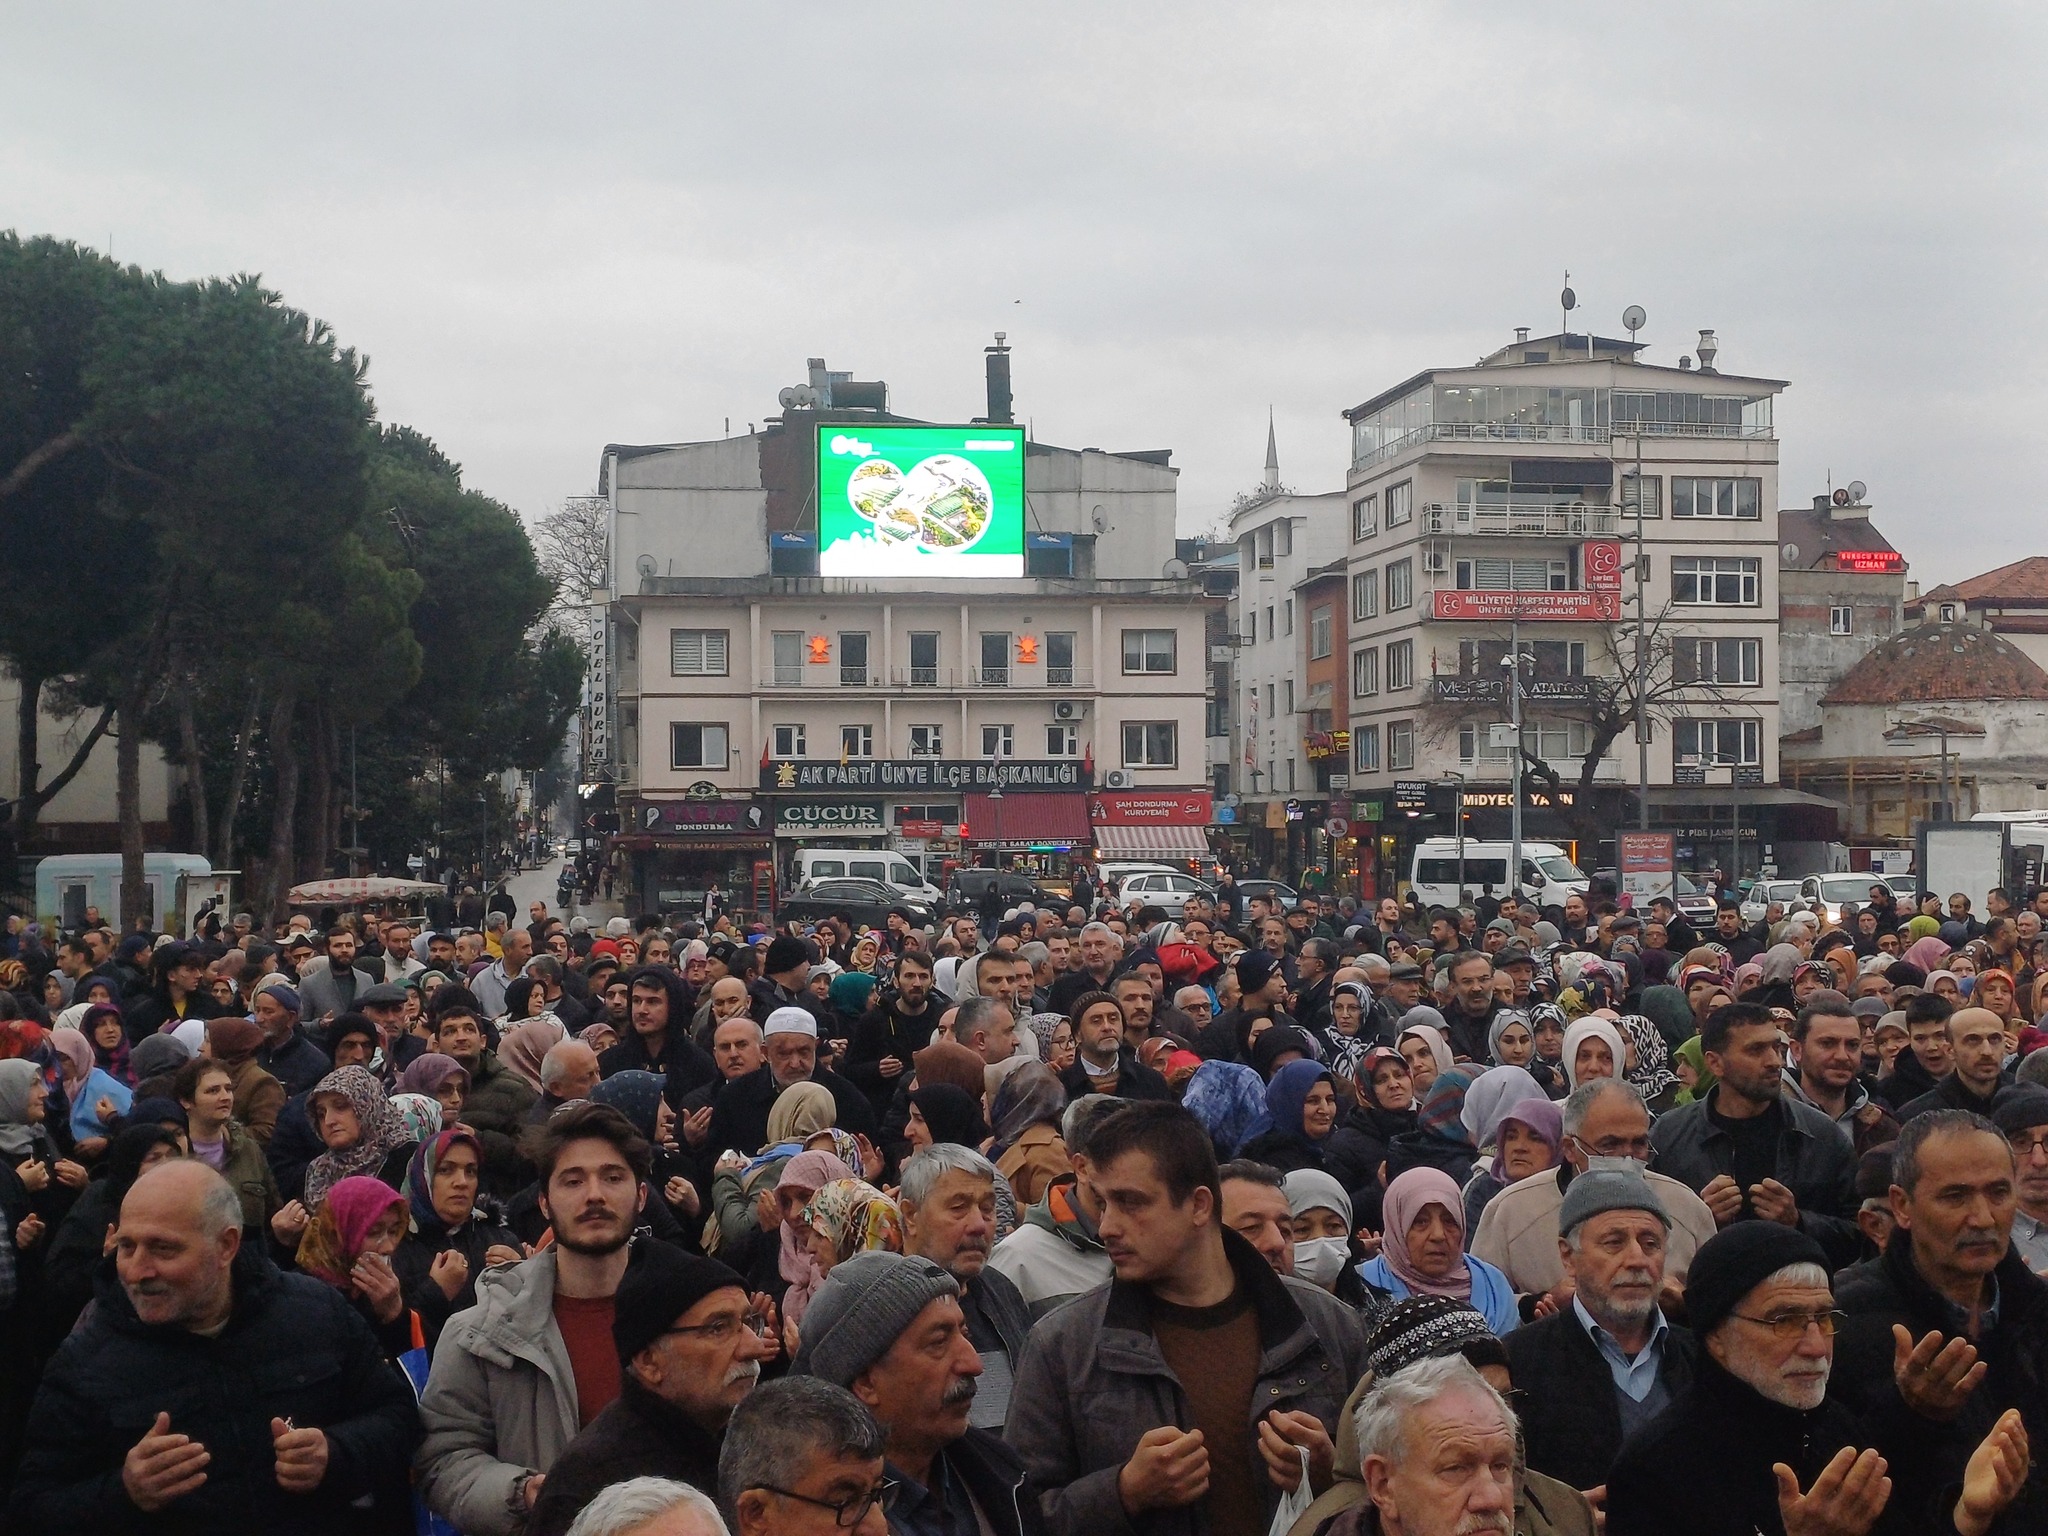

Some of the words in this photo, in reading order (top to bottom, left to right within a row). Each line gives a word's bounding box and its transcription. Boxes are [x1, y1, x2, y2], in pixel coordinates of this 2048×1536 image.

[1854, 560, 1886, 569] UZMAN
[1465, 593, 1513, 605] MİLLİYETÇİ
[1557, 594, 1591, 605] PARTİSİ
[593, 630, 604, 683] OTEL
[593, 692, 605, 758] BURAK
[800, 766, 824, 784] AK
[827, 762, 876, 784] PARTİ
[881, 762, 927, 784] ÜNYE
[933, 762, 971, 788] İLÇE
[976, 763, 1077, 788] BAŞKANLIĞI
[1115, 801, 1132, 809] ŞAH
[1133, 800, 1178, 808] DONDURMA
[783, 804, 879, 821] CÜCÜR
[1124, 808, 1170, 818] KURUYEMİŞ
[675, 823, 733, 831] DONDURMA
